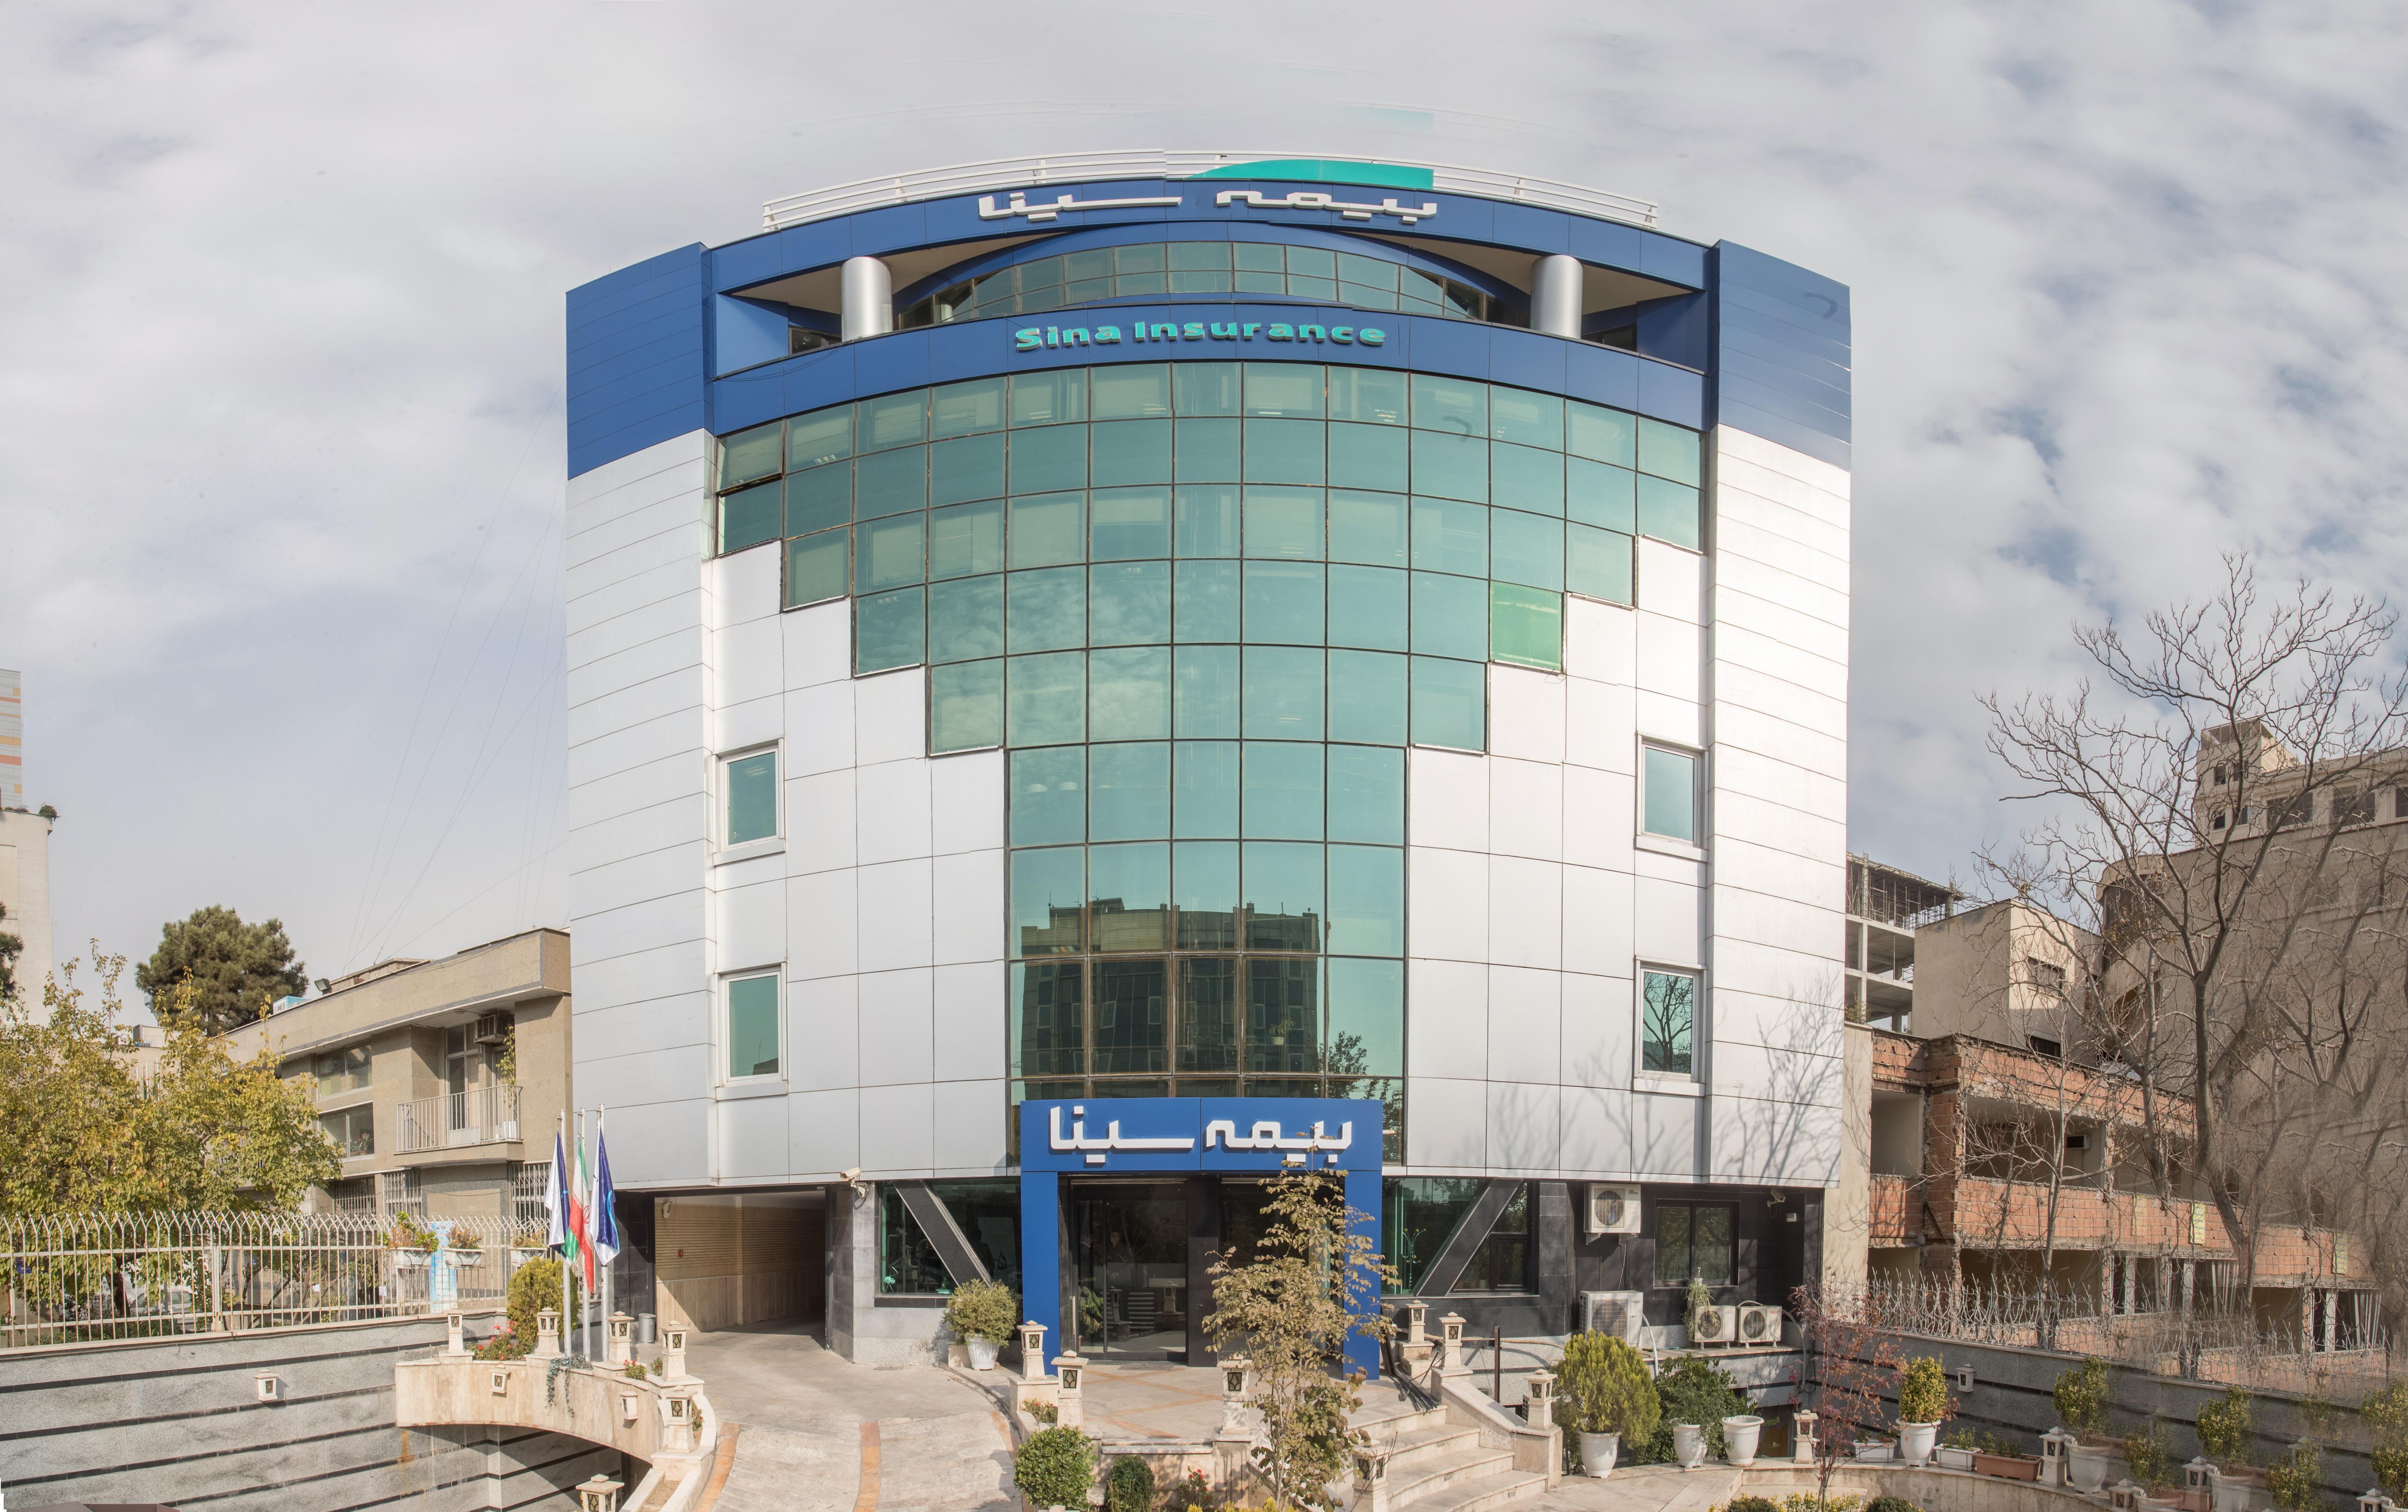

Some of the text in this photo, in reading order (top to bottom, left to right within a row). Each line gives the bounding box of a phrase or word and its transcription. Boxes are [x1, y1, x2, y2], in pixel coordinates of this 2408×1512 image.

[978, 190, 1437, 224] بیمه سینا
[1015, 321, 1386, 351] Sina Insurance
[1050, 1105, 1352, 1163] بیمه سینا
